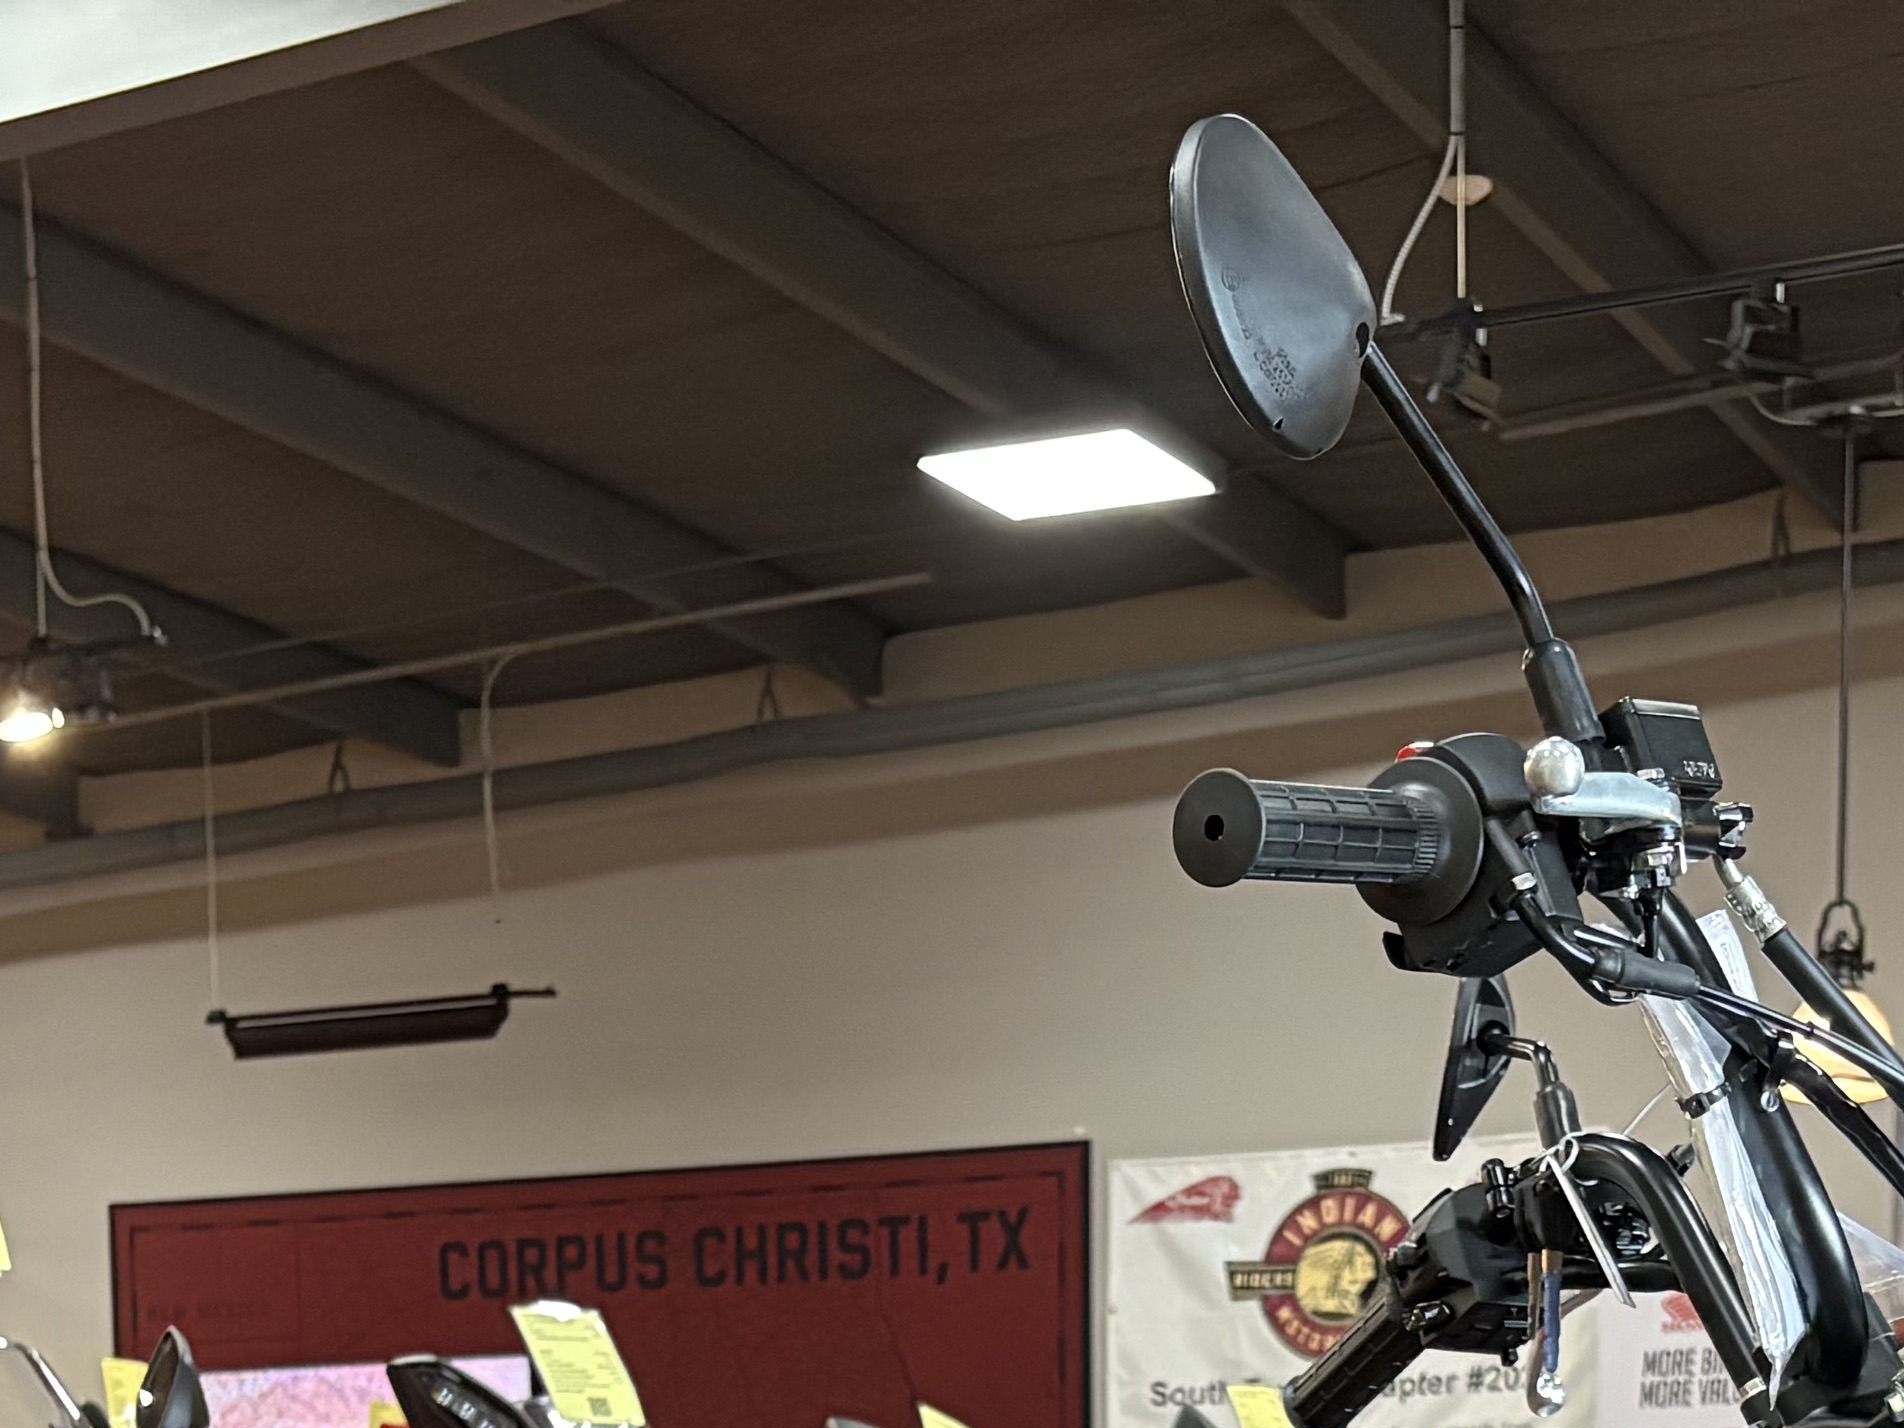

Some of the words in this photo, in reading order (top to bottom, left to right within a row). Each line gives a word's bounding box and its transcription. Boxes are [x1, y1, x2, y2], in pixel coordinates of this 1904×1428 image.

[1283, 1193, 1403, 1249] INDIAN
[438, 1228, 669, 1301] CORPUS
[1642, 1348, 1696, 1378] MORE
[1466, 1364, 1526, 1393] #20
[1639, 1379, 1692, 1408] MORE
